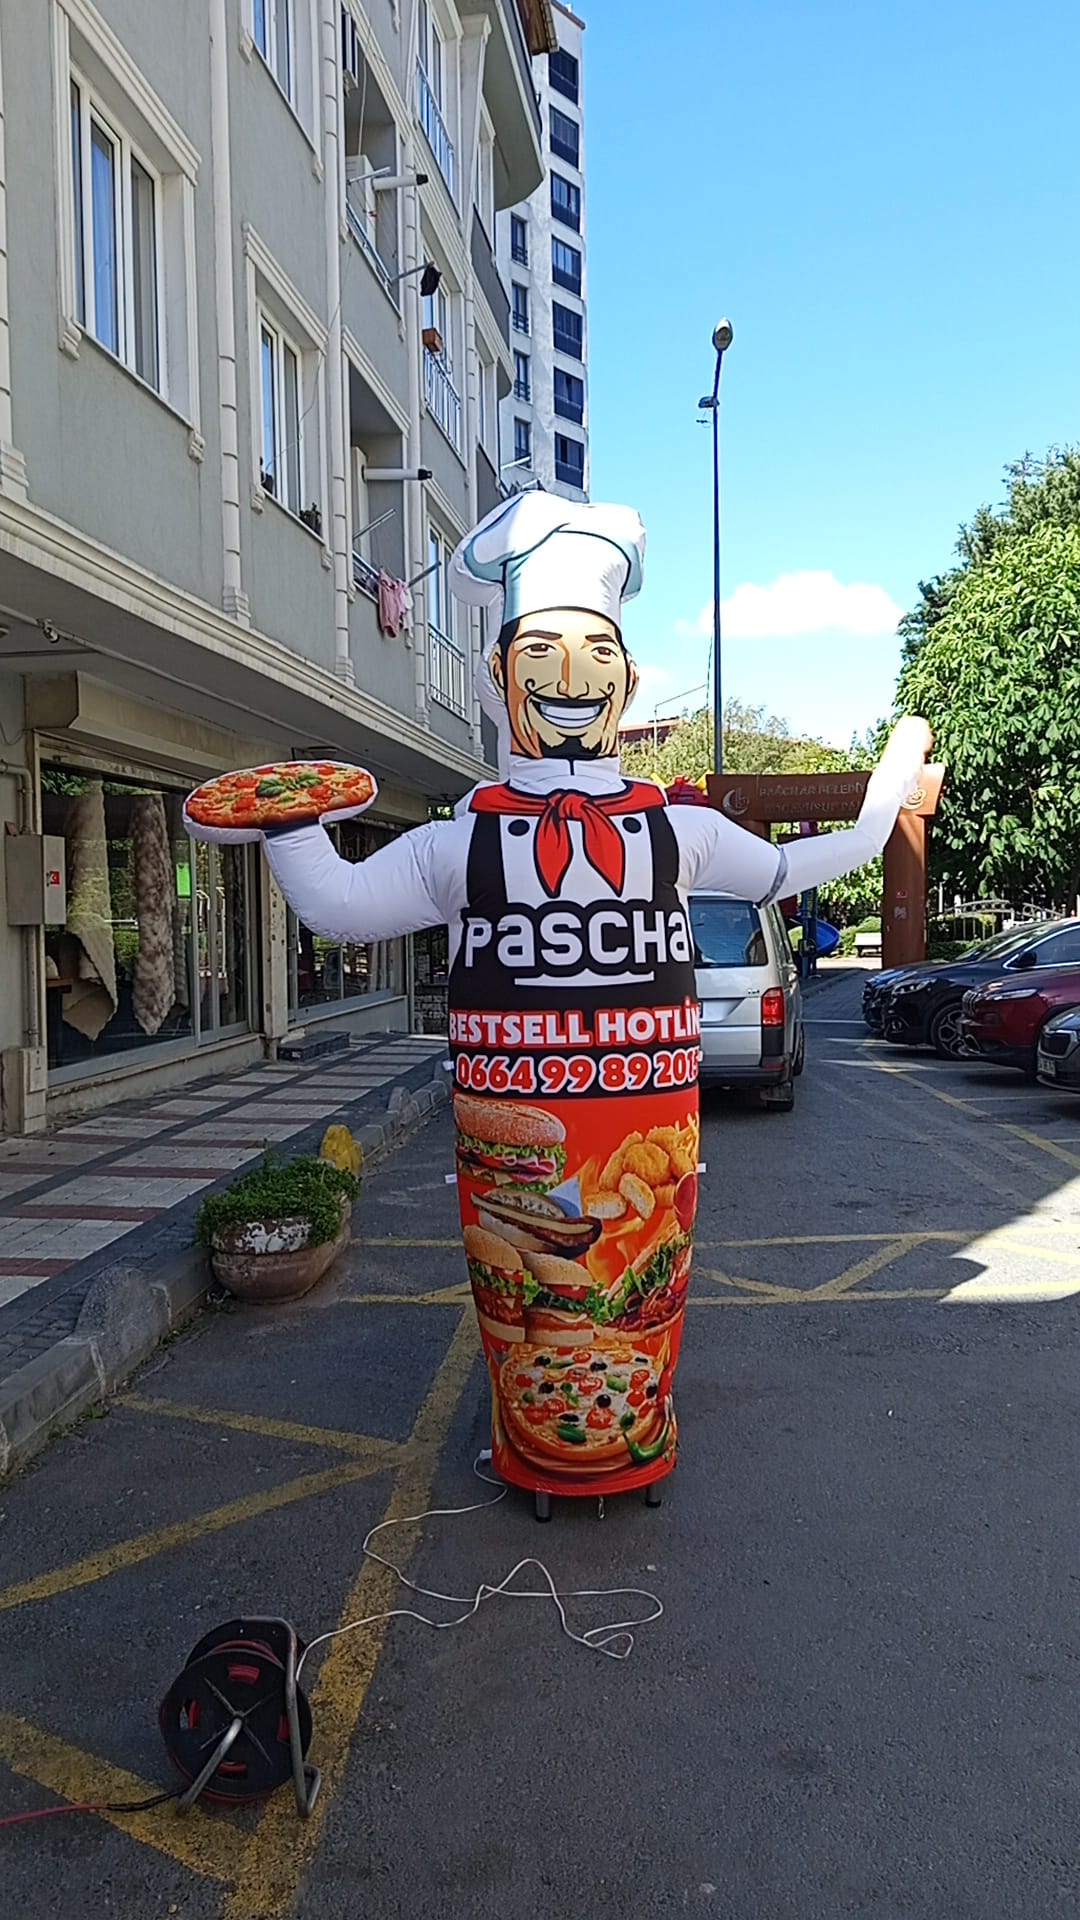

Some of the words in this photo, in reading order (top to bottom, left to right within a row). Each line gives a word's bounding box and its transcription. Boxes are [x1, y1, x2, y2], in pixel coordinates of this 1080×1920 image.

[450, 1012, 591, 1045] BESTSELL
[457, 1054, 534, 1093] 0664
[540, 1054, 597, 1093] 99
[601, 1053, 651, 1092] 89
